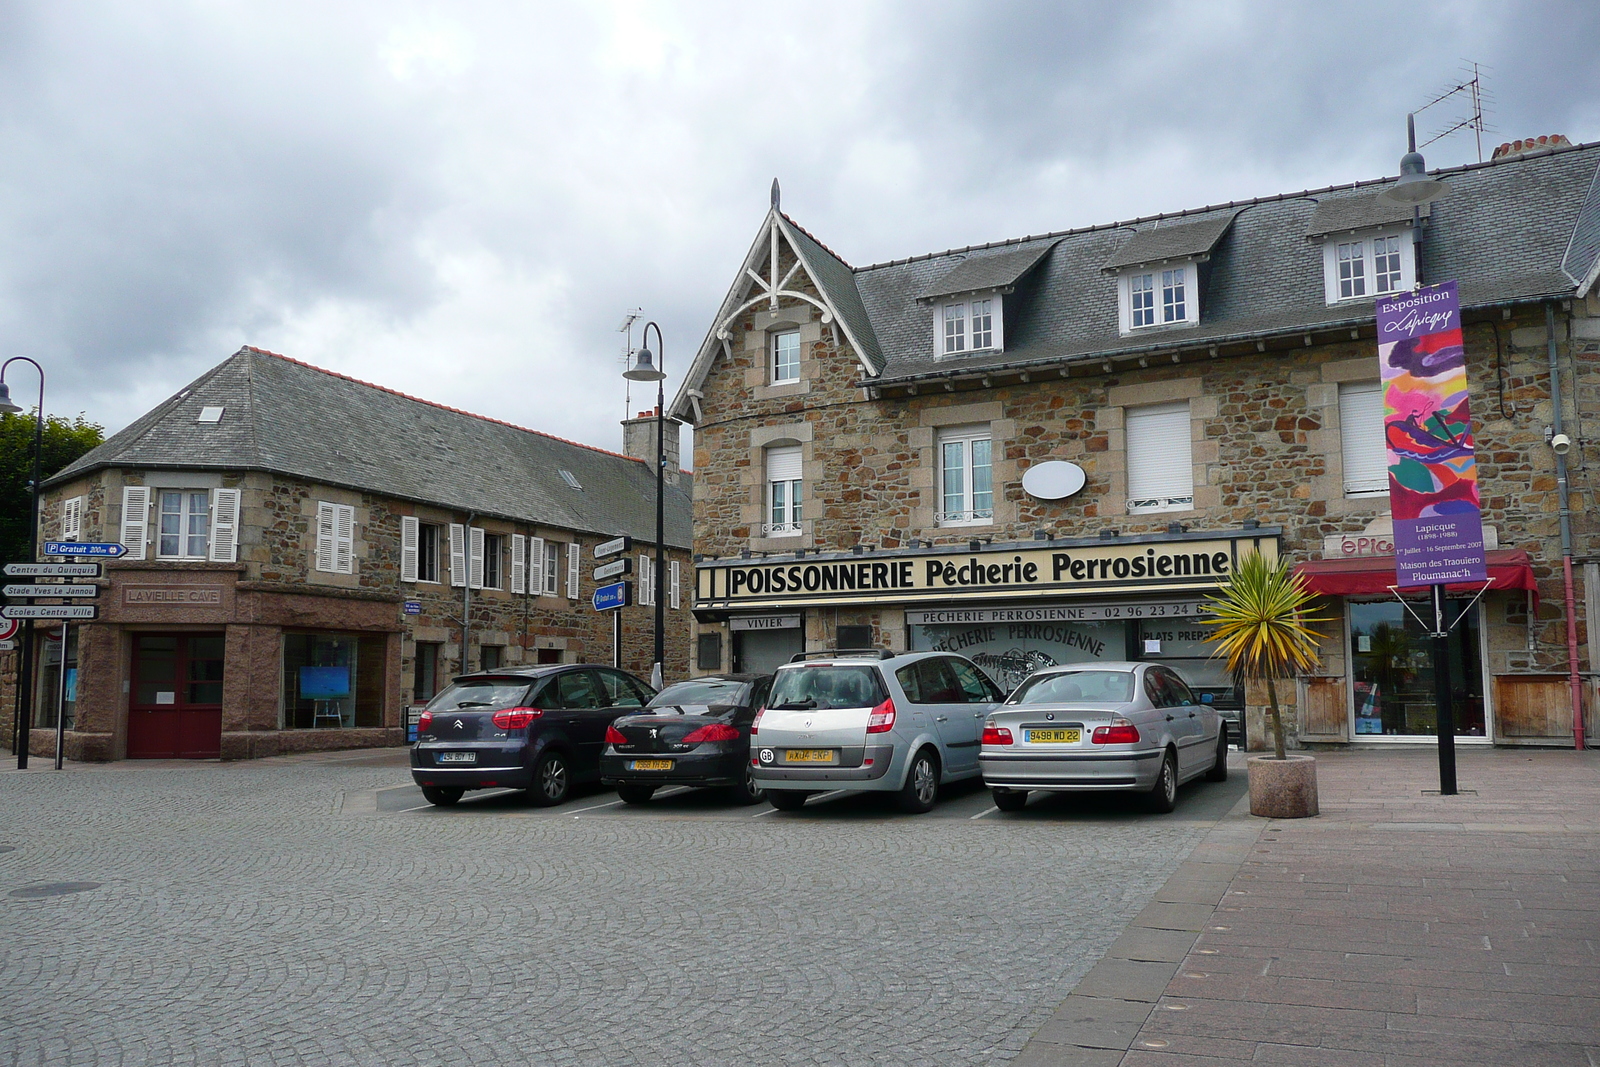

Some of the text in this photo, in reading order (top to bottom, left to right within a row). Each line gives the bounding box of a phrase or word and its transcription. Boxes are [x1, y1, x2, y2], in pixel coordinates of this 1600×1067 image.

[1382, 291, 1450, 313] Exposition
[1415, 522, 1456, 533] Lapicque
[59, 544, 87, 553] Gratuit
[1404, 546, 1421, 556] Juillet
[1434, 543, 1467, 553] Septembre
[1467, 541, 1482, 549] 2007
[1400, 556, 1481, 570] Maison des Traouïero
[57, 566, 95, 575] Quinquis
[731, 548, 1229, 594] POISSONNERIE Pêcherie Perrosienne
[1412, 567, 1471, 581] Ploumanac'h
[8, 586, 93, 594] Stade Yves Le Jannou
[129, 591, 218, 601] LA VIEILLE CAVE
[40, 608, 68, 616] Centre
[73, 608, 92, 616] Ville
[992, 608, 1085, 621] PERROSIENNE
[1105, 607, 1120, 618] 02
[1128, 606, 1143, 617] 96
[1150, 605, 1165, 616] 23
[1173, 604, 1188, 615] 24
[747, 618, 783, 629] VIVIER
[1008, 623, 1106, 658] PERROSIENNE
[1144, 631, 1174, 641] PLATS
[1030, 731, 1079, 740] 9498 WD 22
[761, 750, 773, 760] GB
